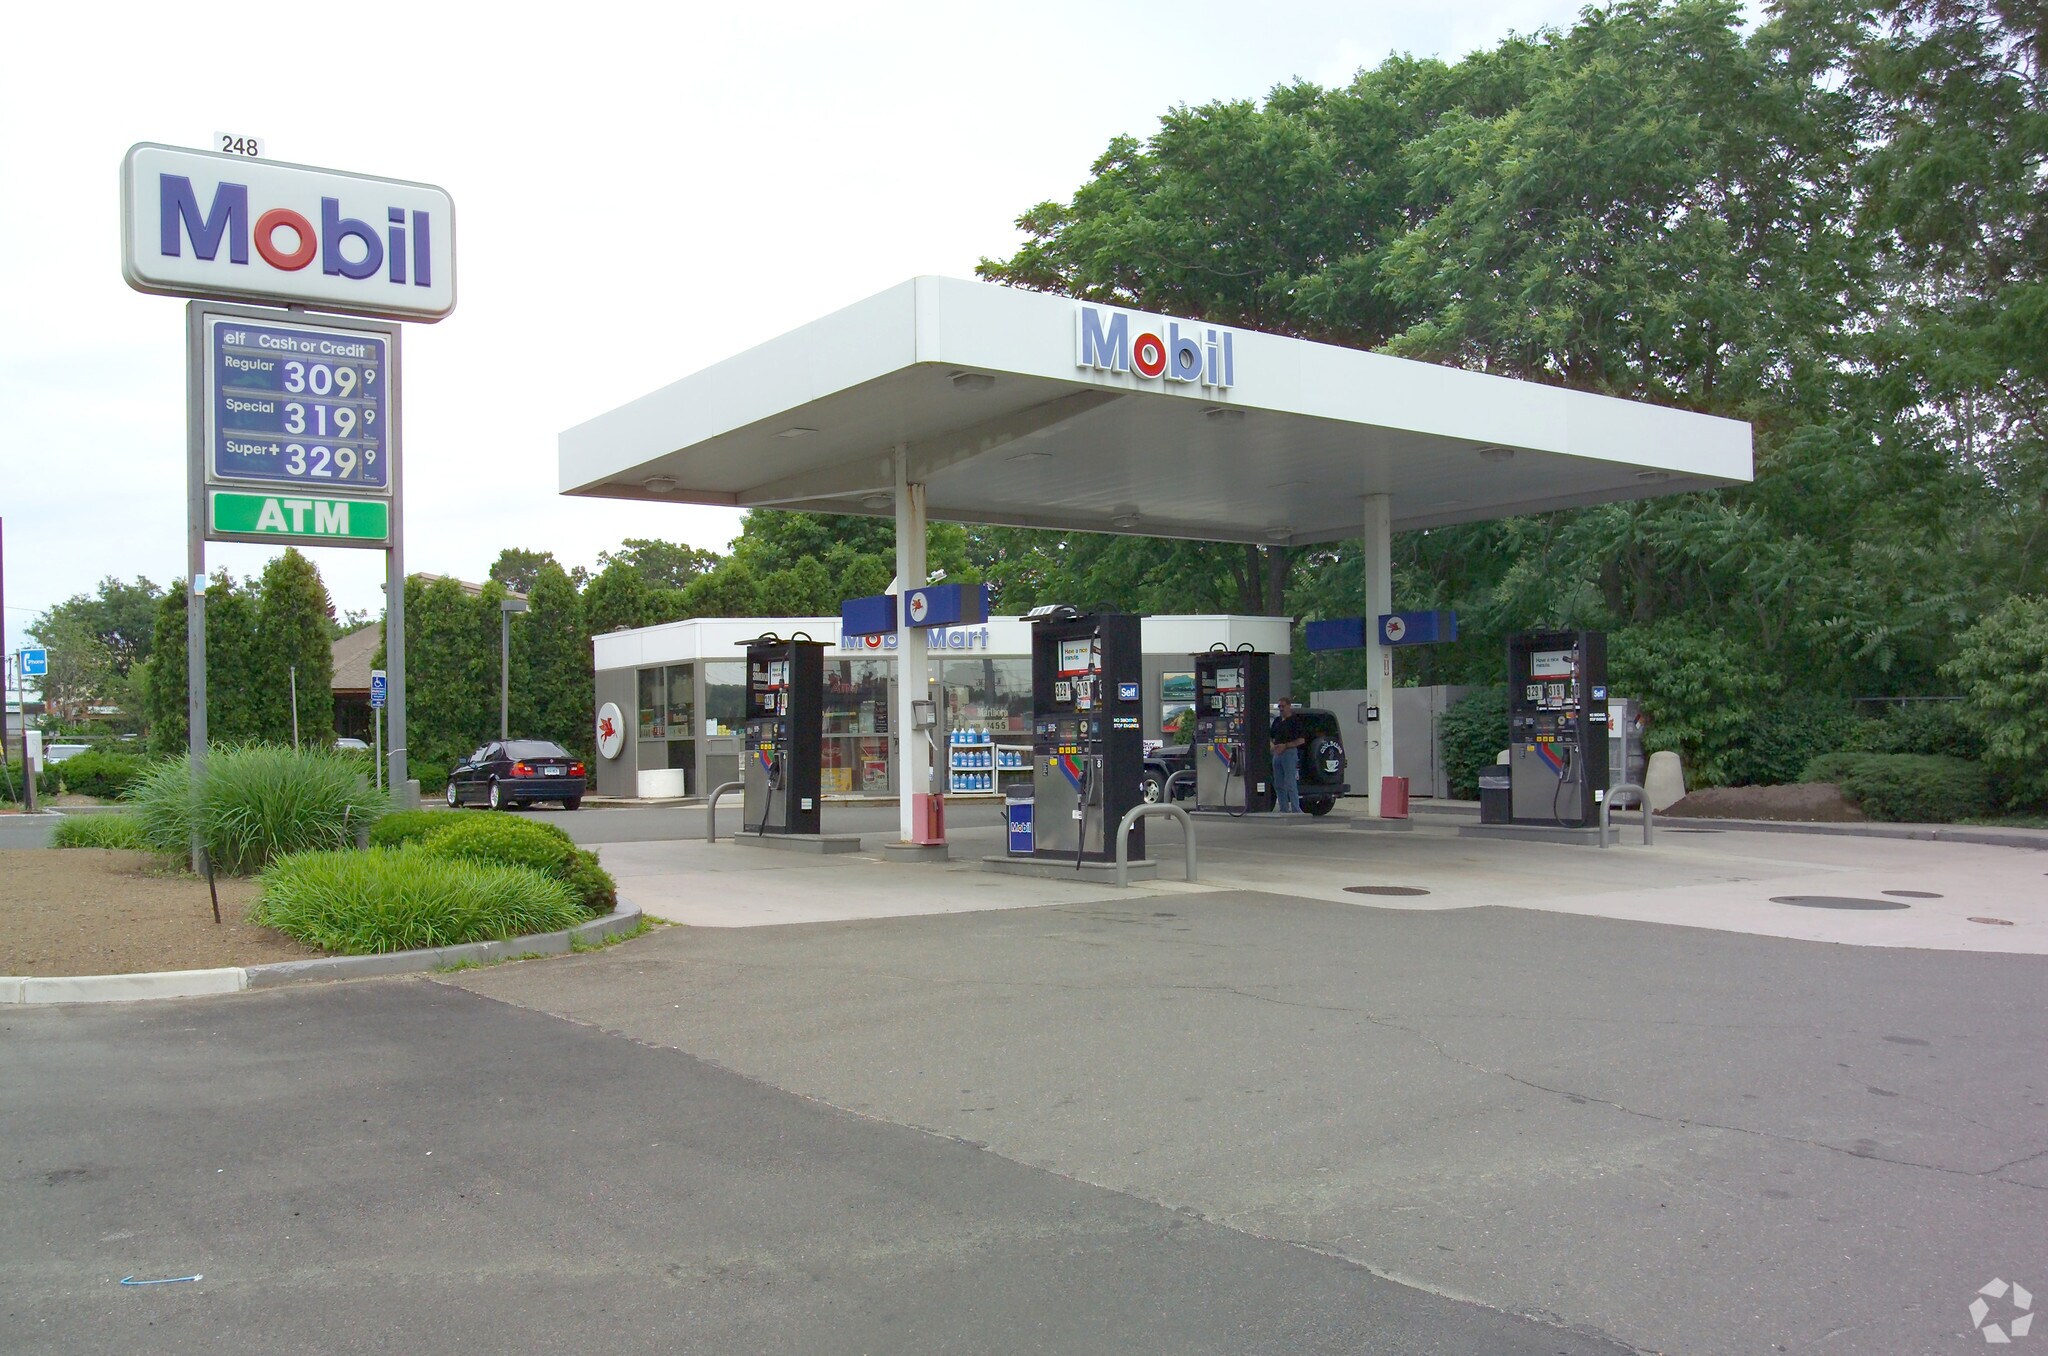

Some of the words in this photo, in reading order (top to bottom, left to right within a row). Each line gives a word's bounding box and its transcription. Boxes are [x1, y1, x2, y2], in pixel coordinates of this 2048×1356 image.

[221, 134, 259, 157] 248
[159, 172, 432, 289] Mobil
[224, 332, 246, 345] elf
[258, 334, 298, 351] Cash
[300, 341, 317, 352] or
[319, 341, 365, 358] Credit
[1080, 306, 1235, 388] Mobil
[225, 356, 275, 371] Regular
[226, 398, 274, 414] Special
[226, 441, 280, 457] Super+
[255, 498, 349, 534] ATM
[927, 626, 989, 650] Mart
[1120, 686, 1137, 698] Self
[1593, 689, 1604, 697] Self
[976, 706, 1009, 718] Marlboro
[1010, 821, 1032, 833] Mobil
